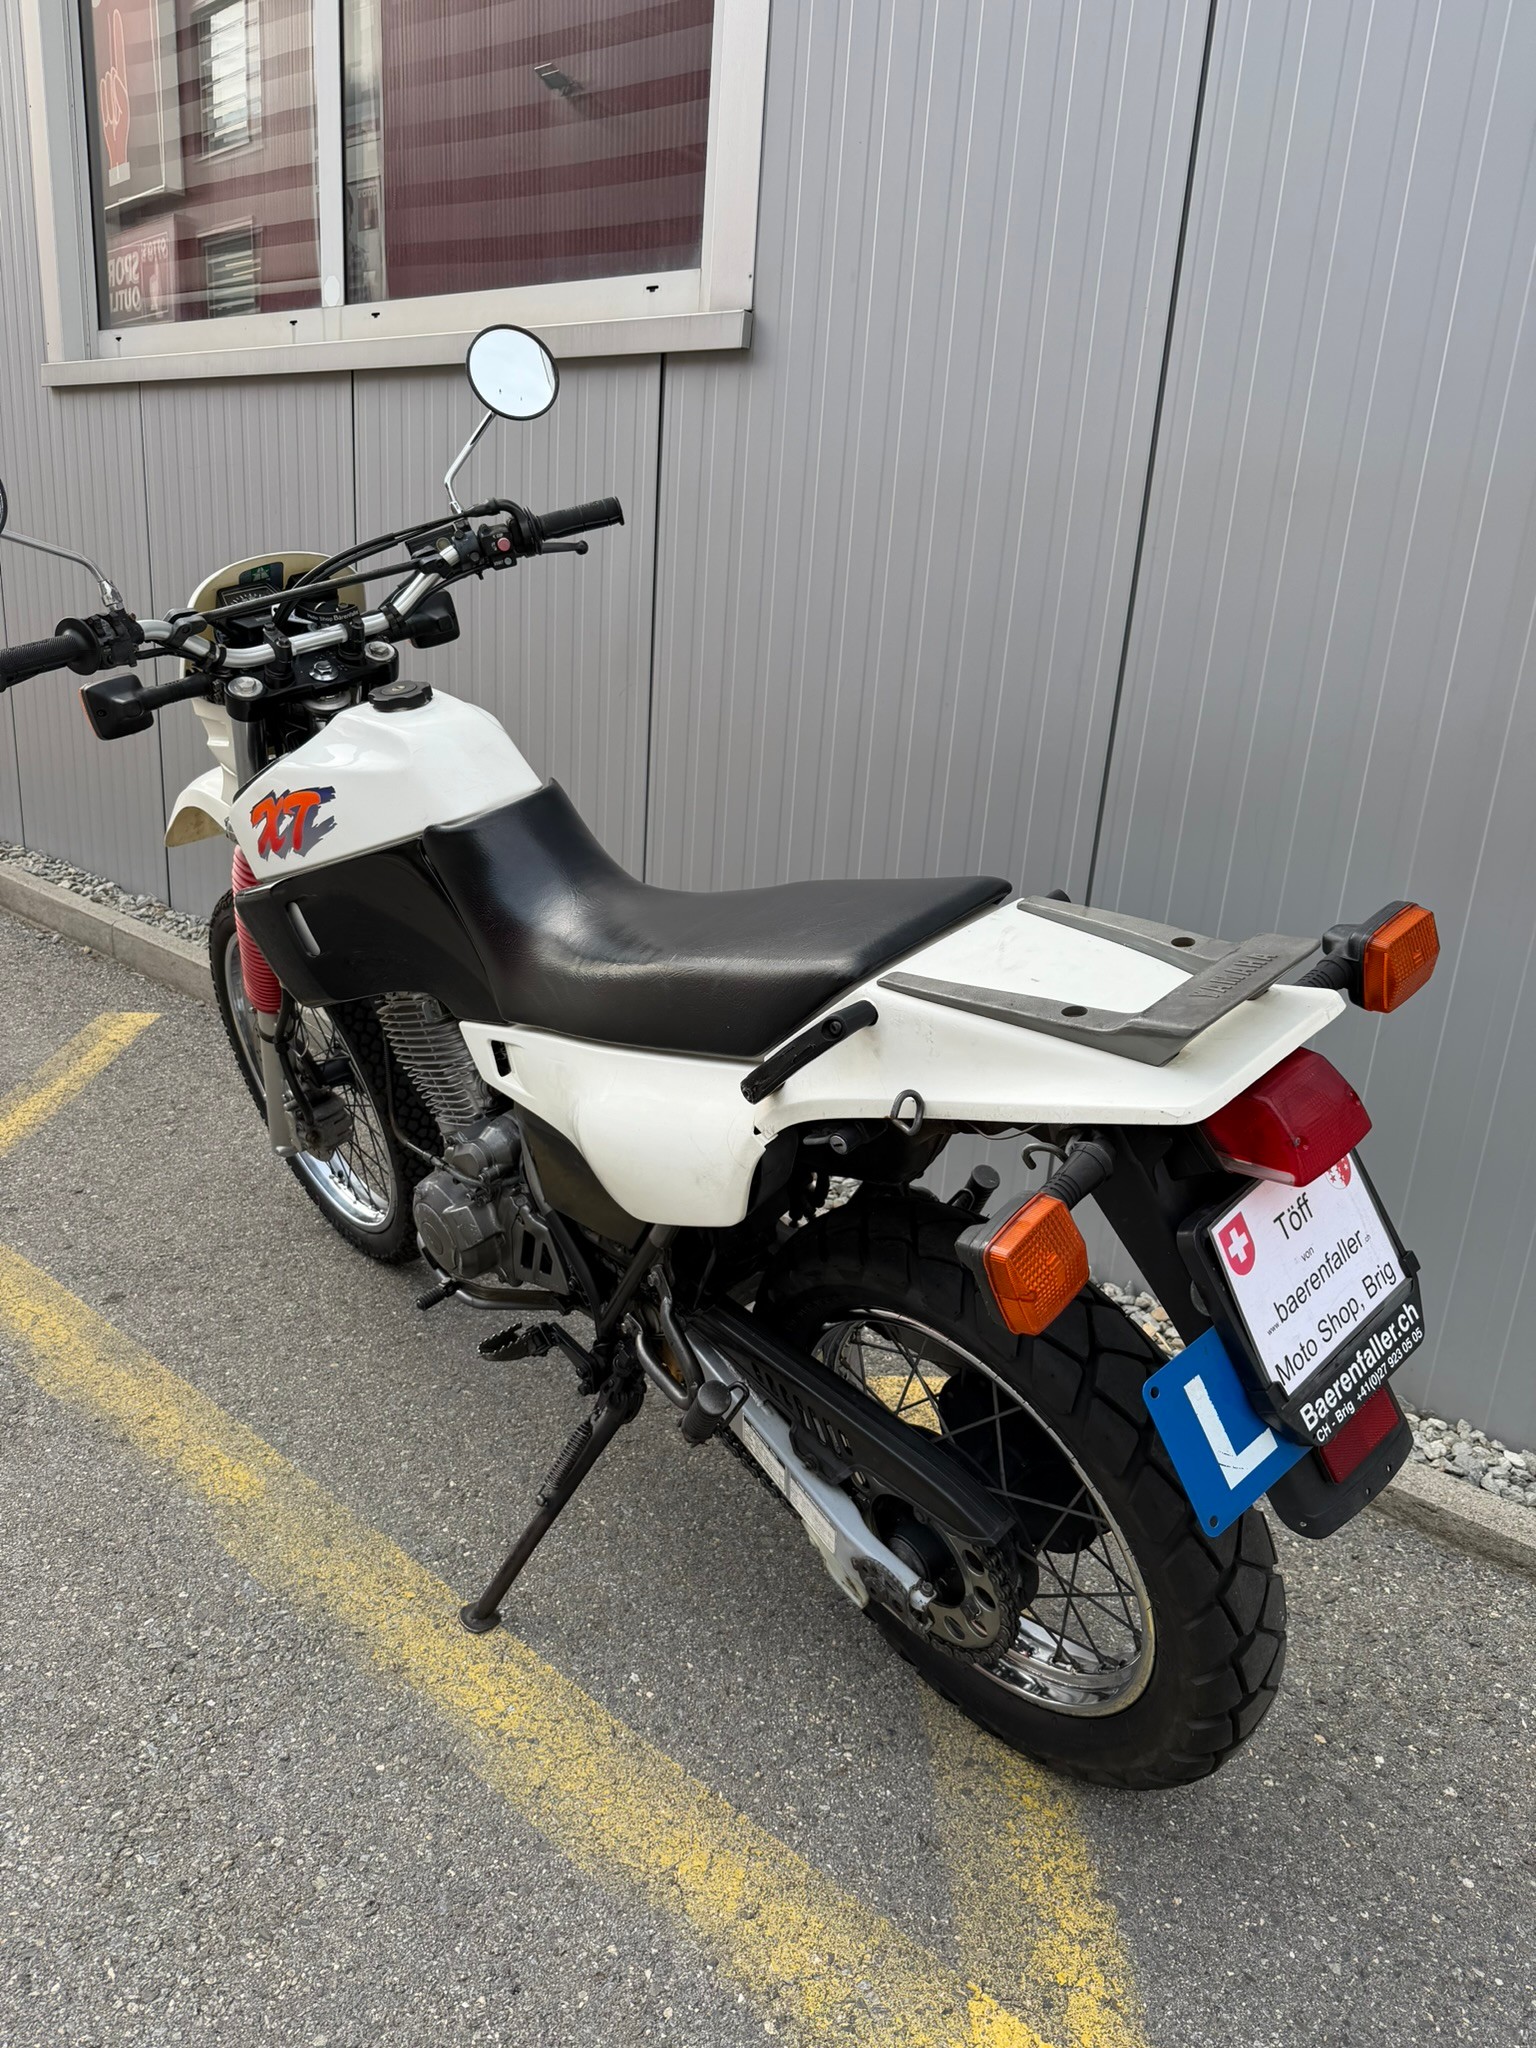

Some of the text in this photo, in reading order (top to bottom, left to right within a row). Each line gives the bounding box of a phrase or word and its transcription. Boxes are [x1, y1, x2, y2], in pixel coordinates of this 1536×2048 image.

[251, 787, 328, 856] XT
[1188, 953, 1278, 999] YAMAHA
[1272, 1191, 1314, 1240] Töff
[1300, 1245, 1316, 1262] von
[1274, 1261, 1397, 1386] Moto Shop, Brig
[1299, 1302, 1420, 1432] Baerenfaller.ch
[1315, 1425, 1332, 1442] CH
[1336, 1400, 1356, 1423] Brig
[1356, 1364, 1388, 1402] +41(0)27
[1387, 1348, 1404, 1369] 923
[1401, 1338, 1414, 1353] 05
[1412, 1326, 1424, 1342] 05
[1183, 1374, 1278, 1491] L
